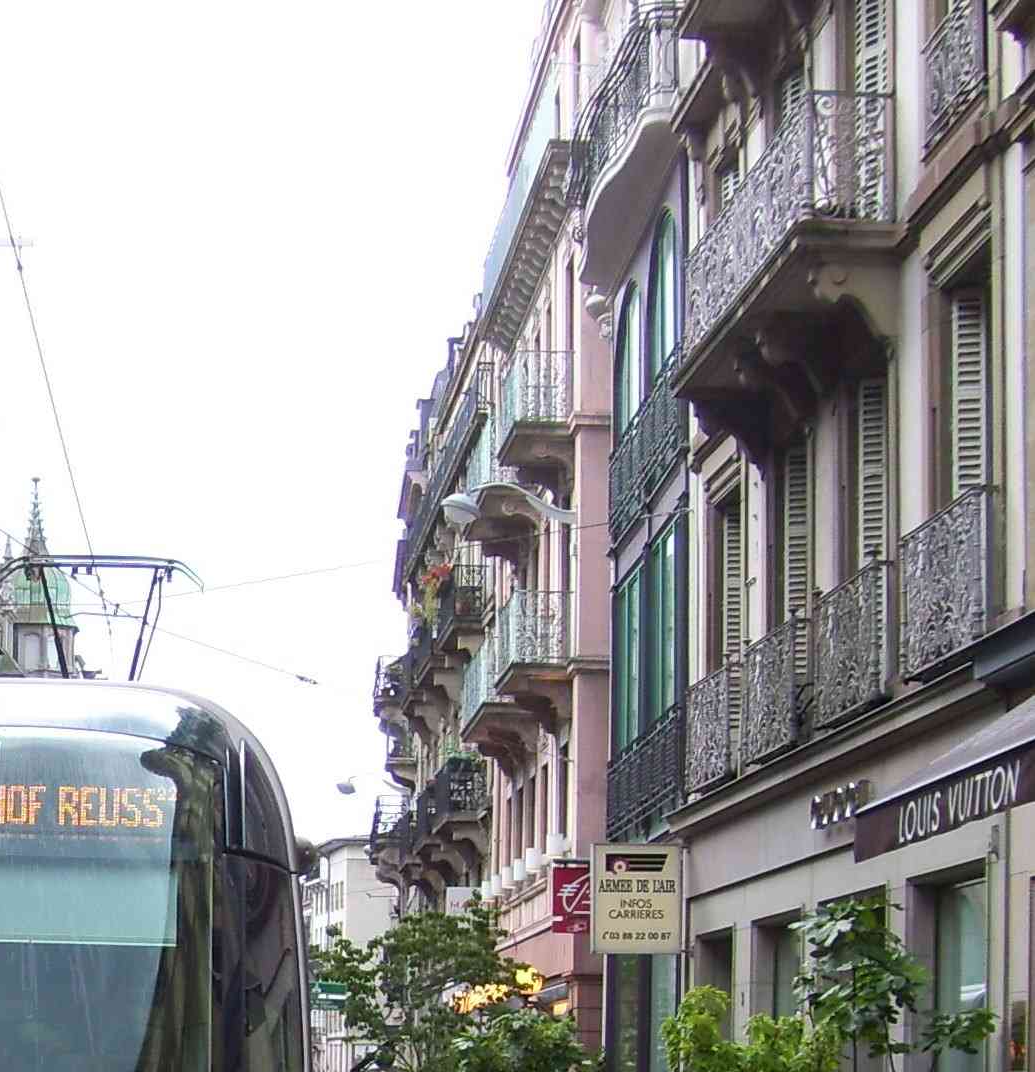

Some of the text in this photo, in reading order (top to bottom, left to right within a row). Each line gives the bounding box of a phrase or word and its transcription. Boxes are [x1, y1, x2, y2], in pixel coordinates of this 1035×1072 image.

[58, 784, 164, 828] REUSS
[898, 791, 942, 843] LOUIS
[948, 760, 1021, 825] VUITTON
[598, 879, 676, 893] ARMEE DE L'AIR
[620, 898, 652, 909] INFOS
[609, 931, 620, 940] 03
[622, 931, 633, 940] 88
[635, 931, 646, 940] 22
[647, 931, 659, 940] 00
